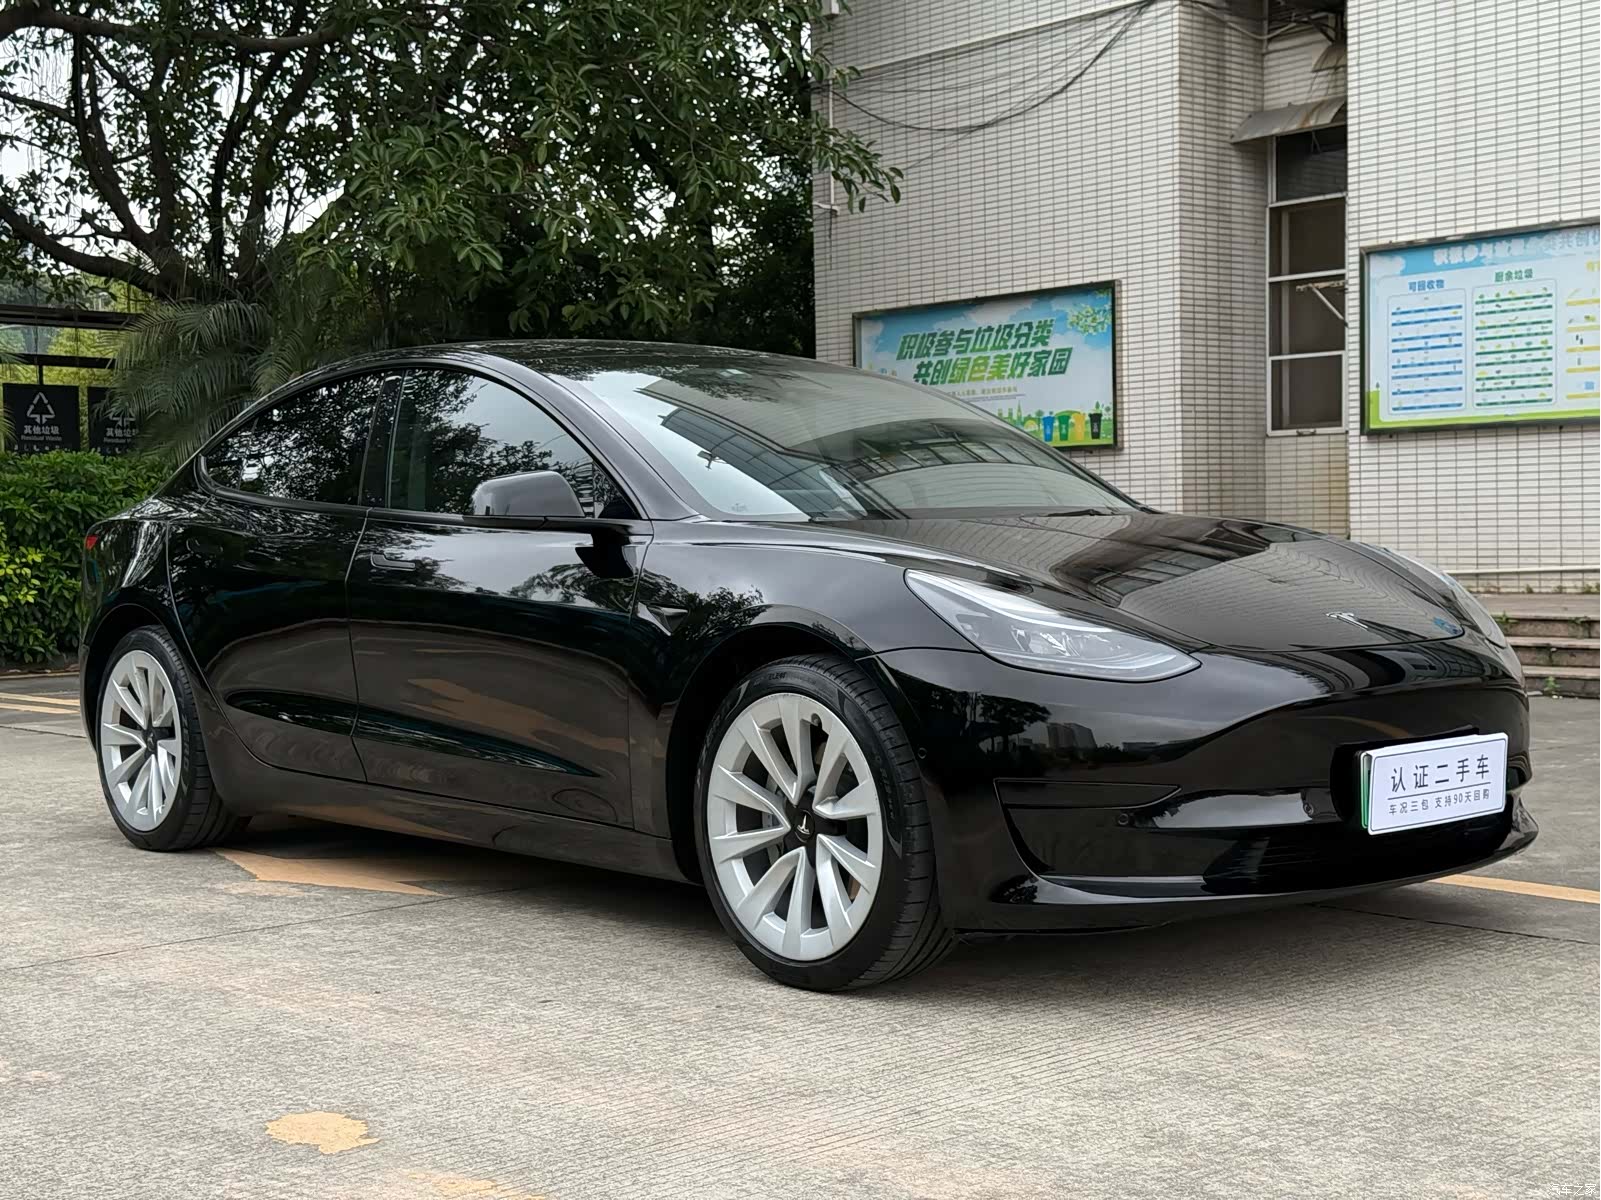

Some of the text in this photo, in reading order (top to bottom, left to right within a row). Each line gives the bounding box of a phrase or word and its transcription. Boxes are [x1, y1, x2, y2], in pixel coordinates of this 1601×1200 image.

[1408, 279, 1445, 293] 可回收物
[896, 319, 1055, 360] 积极参与垃圾分类
[912, 347, 1073, 386] 共创绿色美好家园
[23, 425, 60, 435] 其他垃圾
[1391, 754, 1490, 793] 认证二手车
[1389, 788, 1490, 816] 车况三包 支持90天回购
